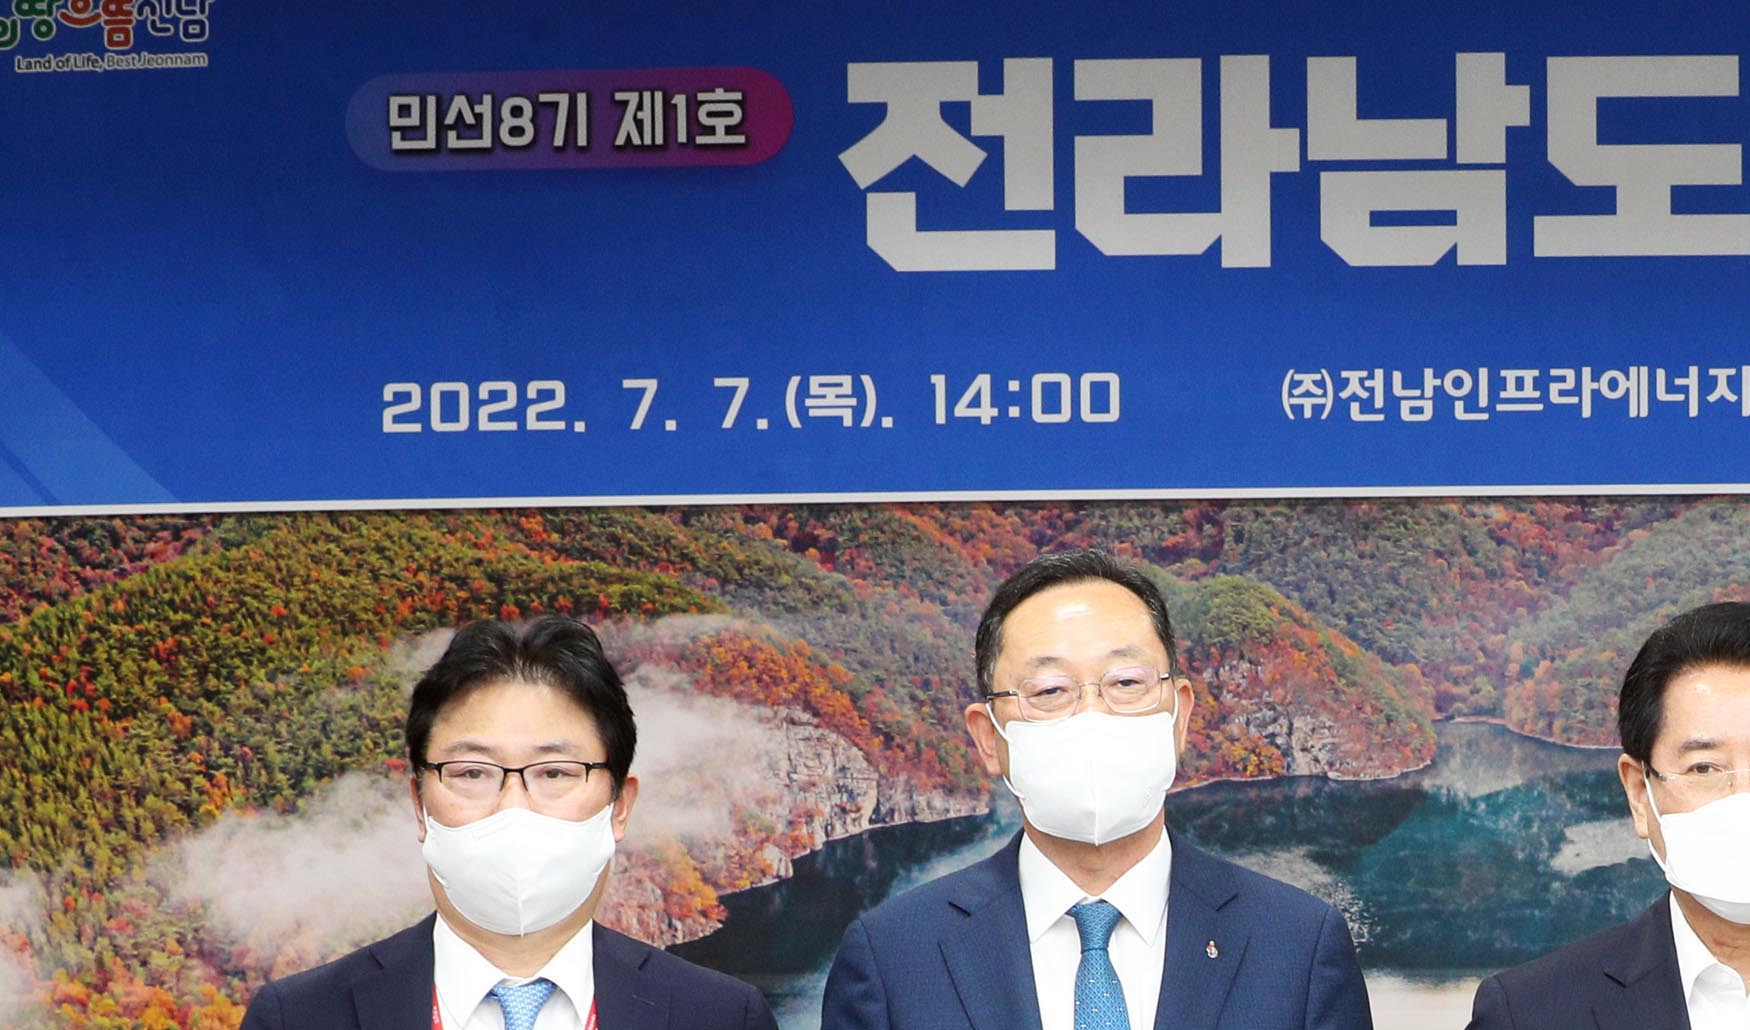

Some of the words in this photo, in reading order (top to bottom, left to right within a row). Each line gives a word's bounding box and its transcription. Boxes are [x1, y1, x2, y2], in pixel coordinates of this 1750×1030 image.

[16, 56, 51, 71] Land
[56, 55, 72, 70] of
[73, 55, 104, 71] Life,
[106, 54, 137, 68] Best
[138, 53, 207, 68] Jeonnam
[389, 92, 588, 150] 민선8기
[614, 88, 746, 146] 제1호
[382, 380, 586, 433] 2022.
[929, 372, 1122, 427] 14:00
